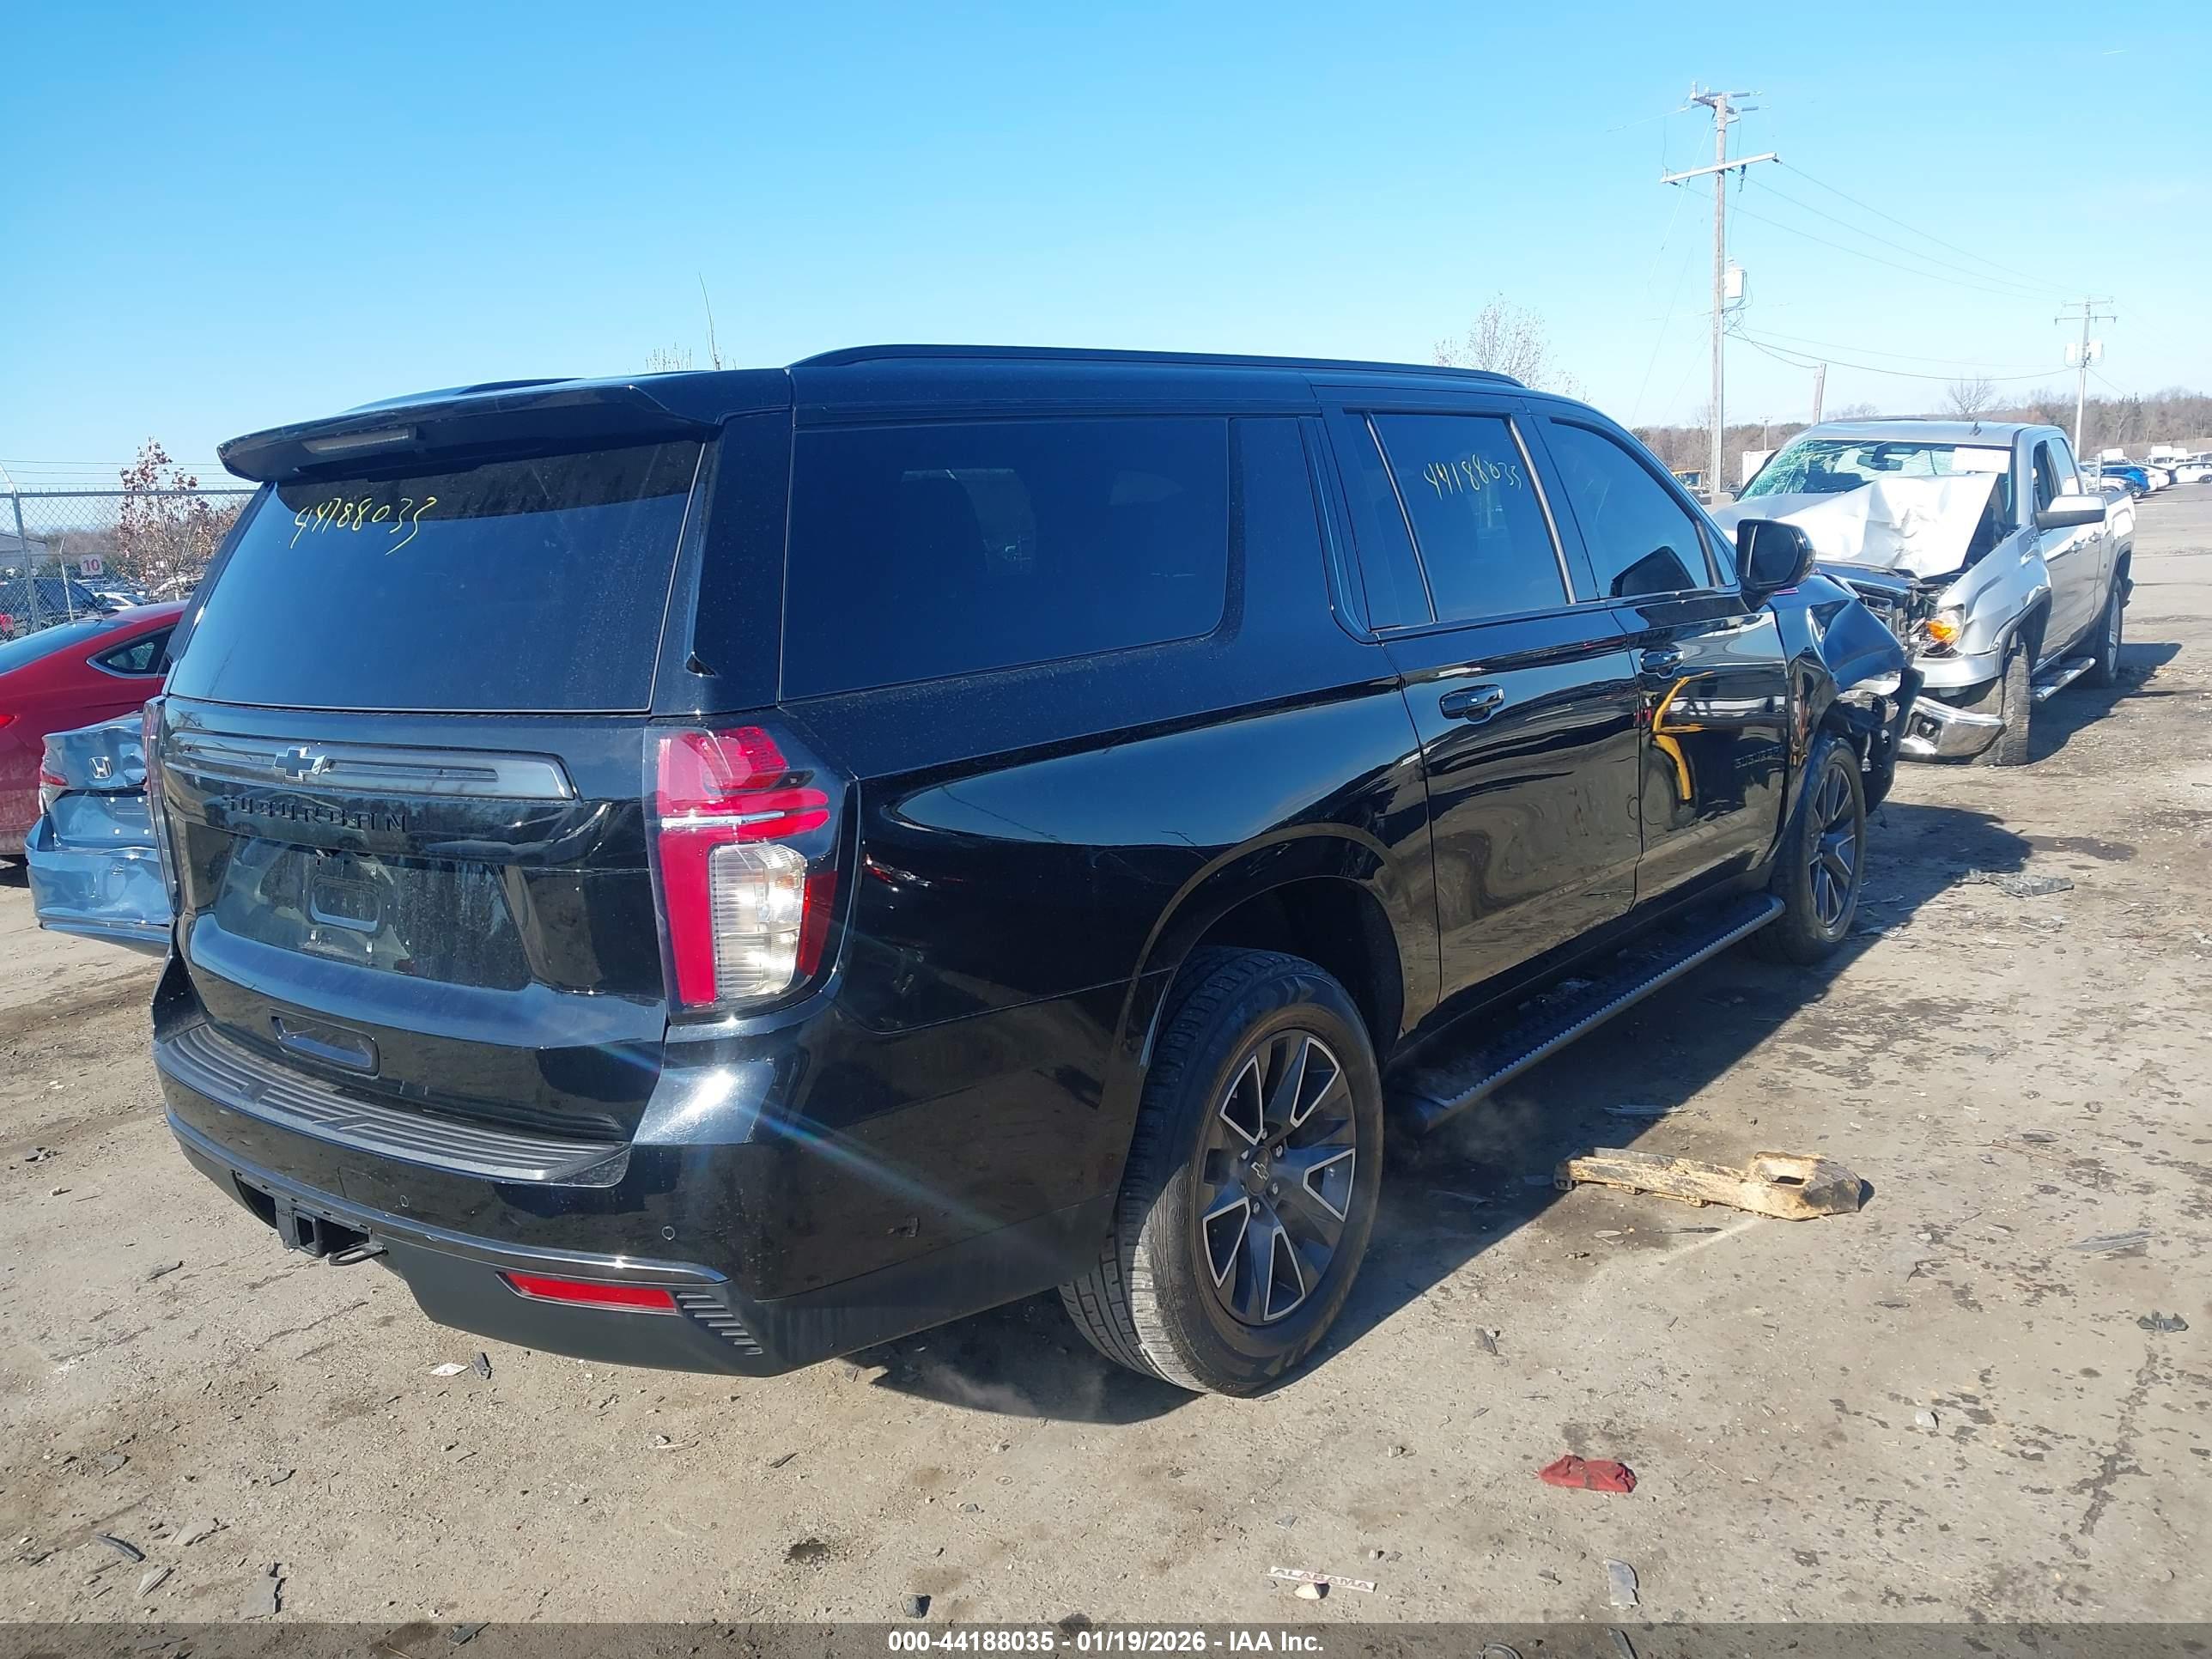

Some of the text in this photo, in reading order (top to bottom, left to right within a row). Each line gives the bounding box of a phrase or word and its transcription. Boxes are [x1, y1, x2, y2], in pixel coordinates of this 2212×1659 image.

[83, 559, 100, 572] 10
[1734, 744, 1784, 769] SUBURBA
[222, 794, 406, 833] SUBURBAN
